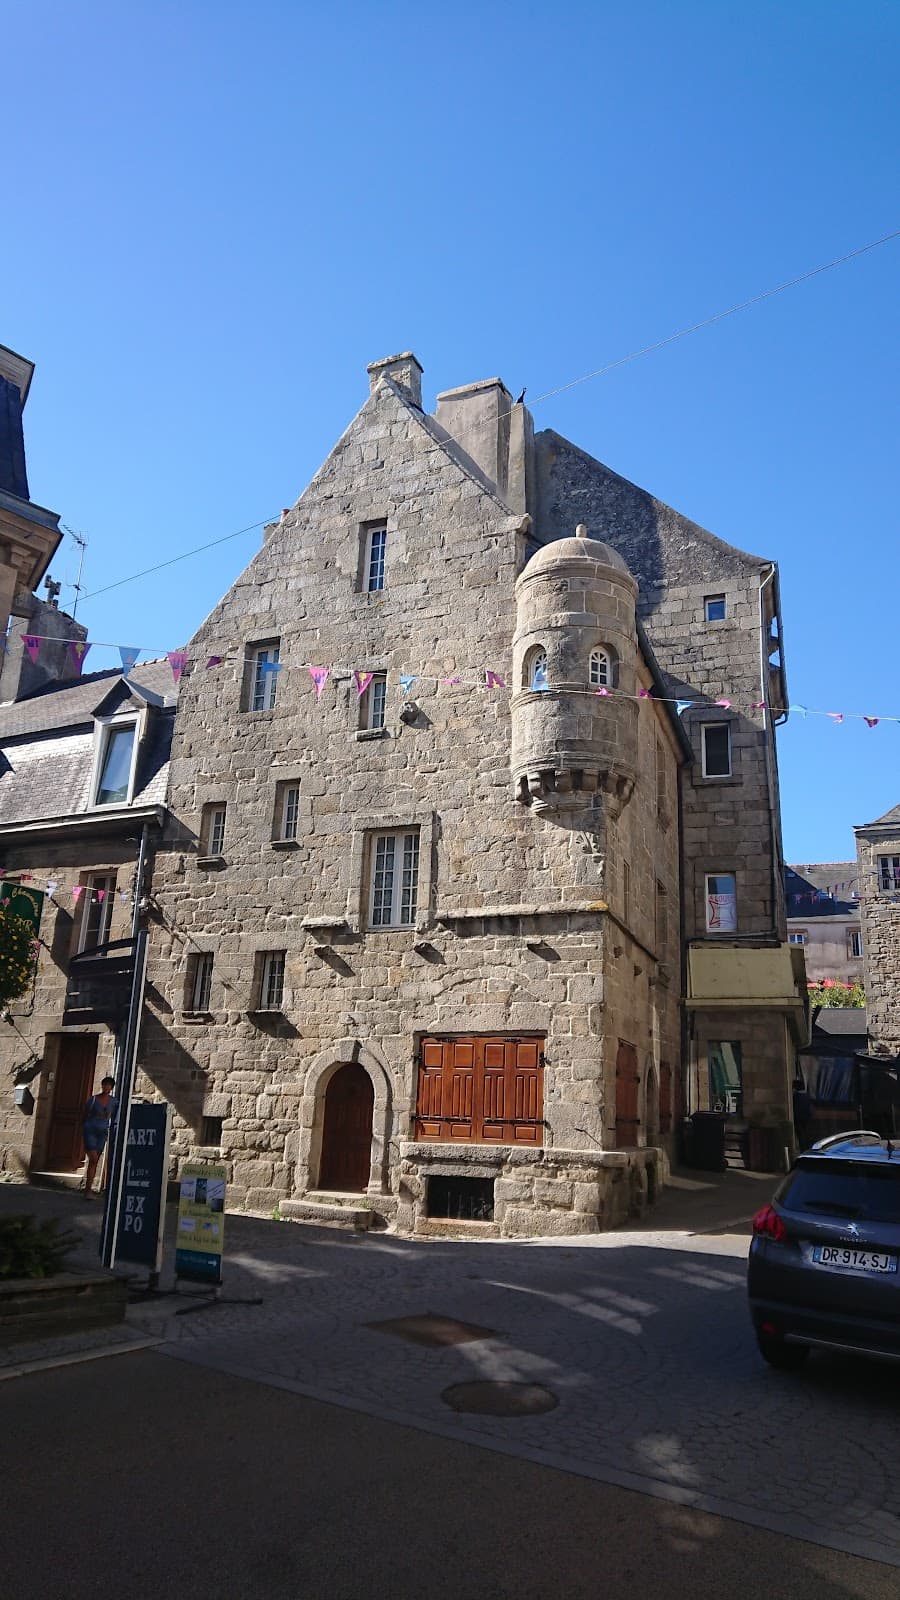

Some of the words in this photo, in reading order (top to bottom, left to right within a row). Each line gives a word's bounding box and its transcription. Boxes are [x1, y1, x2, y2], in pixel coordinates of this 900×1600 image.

[127, 1129, 156, 1146] ART
[125, 1195, 145, 1213] EX
[124, 1214, 143, 1233] PO
[822, 1247, 889, 1269] DR-914-SJ
